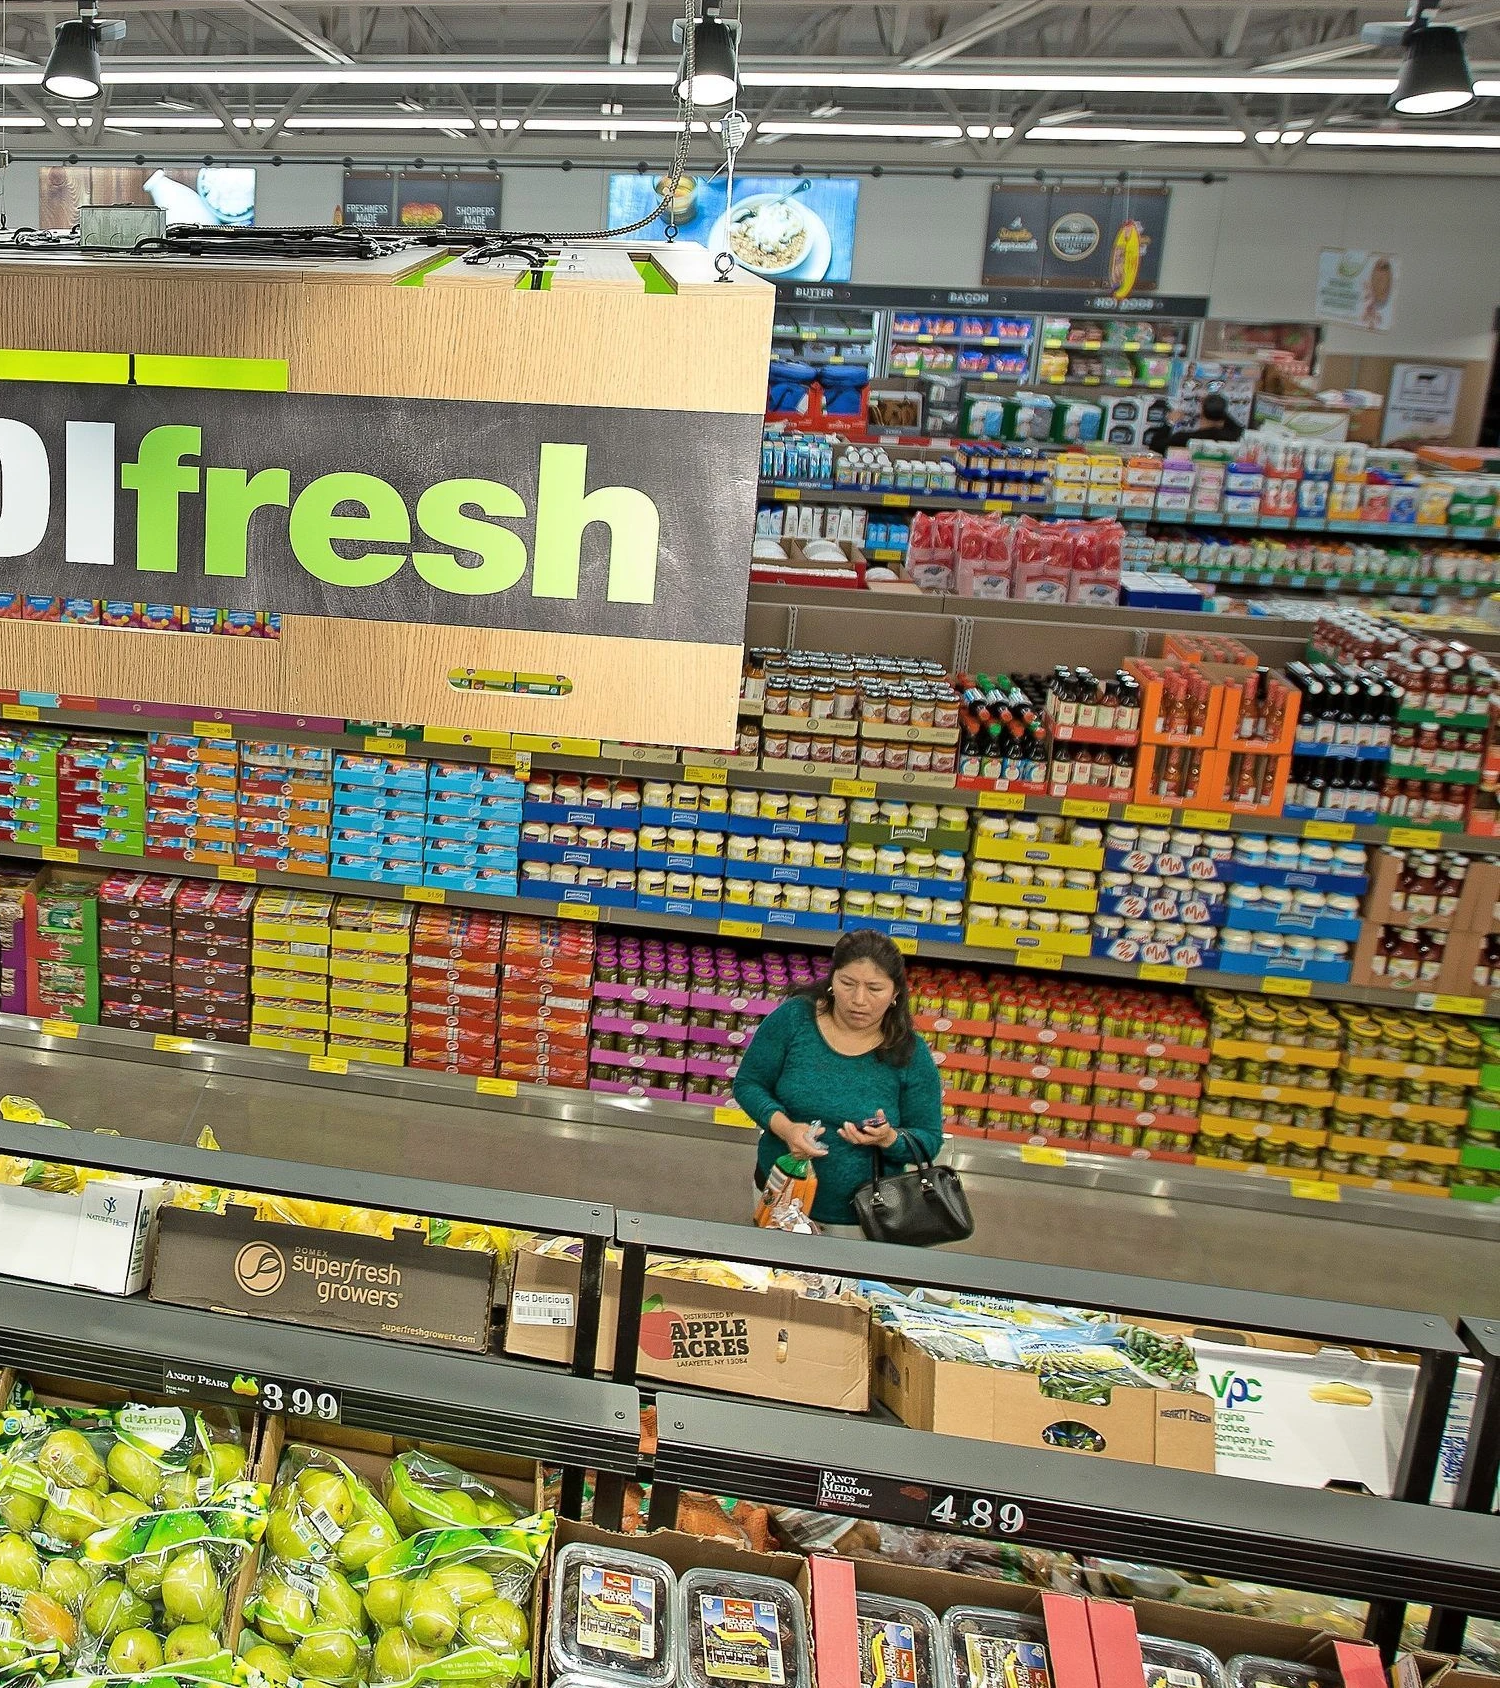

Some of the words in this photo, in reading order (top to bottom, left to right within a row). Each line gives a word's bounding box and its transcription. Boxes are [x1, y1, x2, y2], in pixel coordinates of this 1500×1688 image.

[346, 203, 388, 214] FRESHNESS
[456, 206, 496, 217] SHOPPERS
[356, 213, 377, 222] MADE
[464, 216, 486, 225] MADE
[796, 287, 834, 298] BUTTER
[949, 293, 990, 304] BACON
[86, 1212, 113, 1224] NATURE'S
[113, 1218, 129, 1229] HOPE
[295, 1246, 329, 1259] DOMEX
[291, 1253, 402, 1286] superfresh
[316, 1279, 400, 1310] growers
[515, 1292, 530, 1302] Red
[532, 1292, 570, 1306] Delicious
[683, 1312, 725, 1321] DISTRIBUTED
[381, 1322, 476, 1345] superfreshgrowers.com
[671, 1318, 748, 1341] APPLE
[672, 1337, 750, 1360] ACRES
[676, 1360, 713, 1369] LAFAYETTE,
[714, 1359, 725, 1367] NY
[726, 1357, 749, 1367] 13084
[166, 1369, 195, 1383] ANJOU
[198, 1375, 229, 1390] PEARS
[262, 1383, 339, 1421] 3.99
[124, 1408, 182, 1427] d'Anjou
[1160, 1408, 1187, 1421] HEARTY
[1189, 1409, 1213, 1424] FRESH
[1257, 1437, 1276, 1449] Inc.
[823, 1471, 858, 1486] FANCY
[823, 1480, 873, 1497] MEDJOOL
[821, 1490, 856, 1503] DATES
[931, 1494, 1025, 1533] 4.89
[721, 1615, 758, 1627] MEDJOOL
[724, 1622, 754, 1632] DATES
